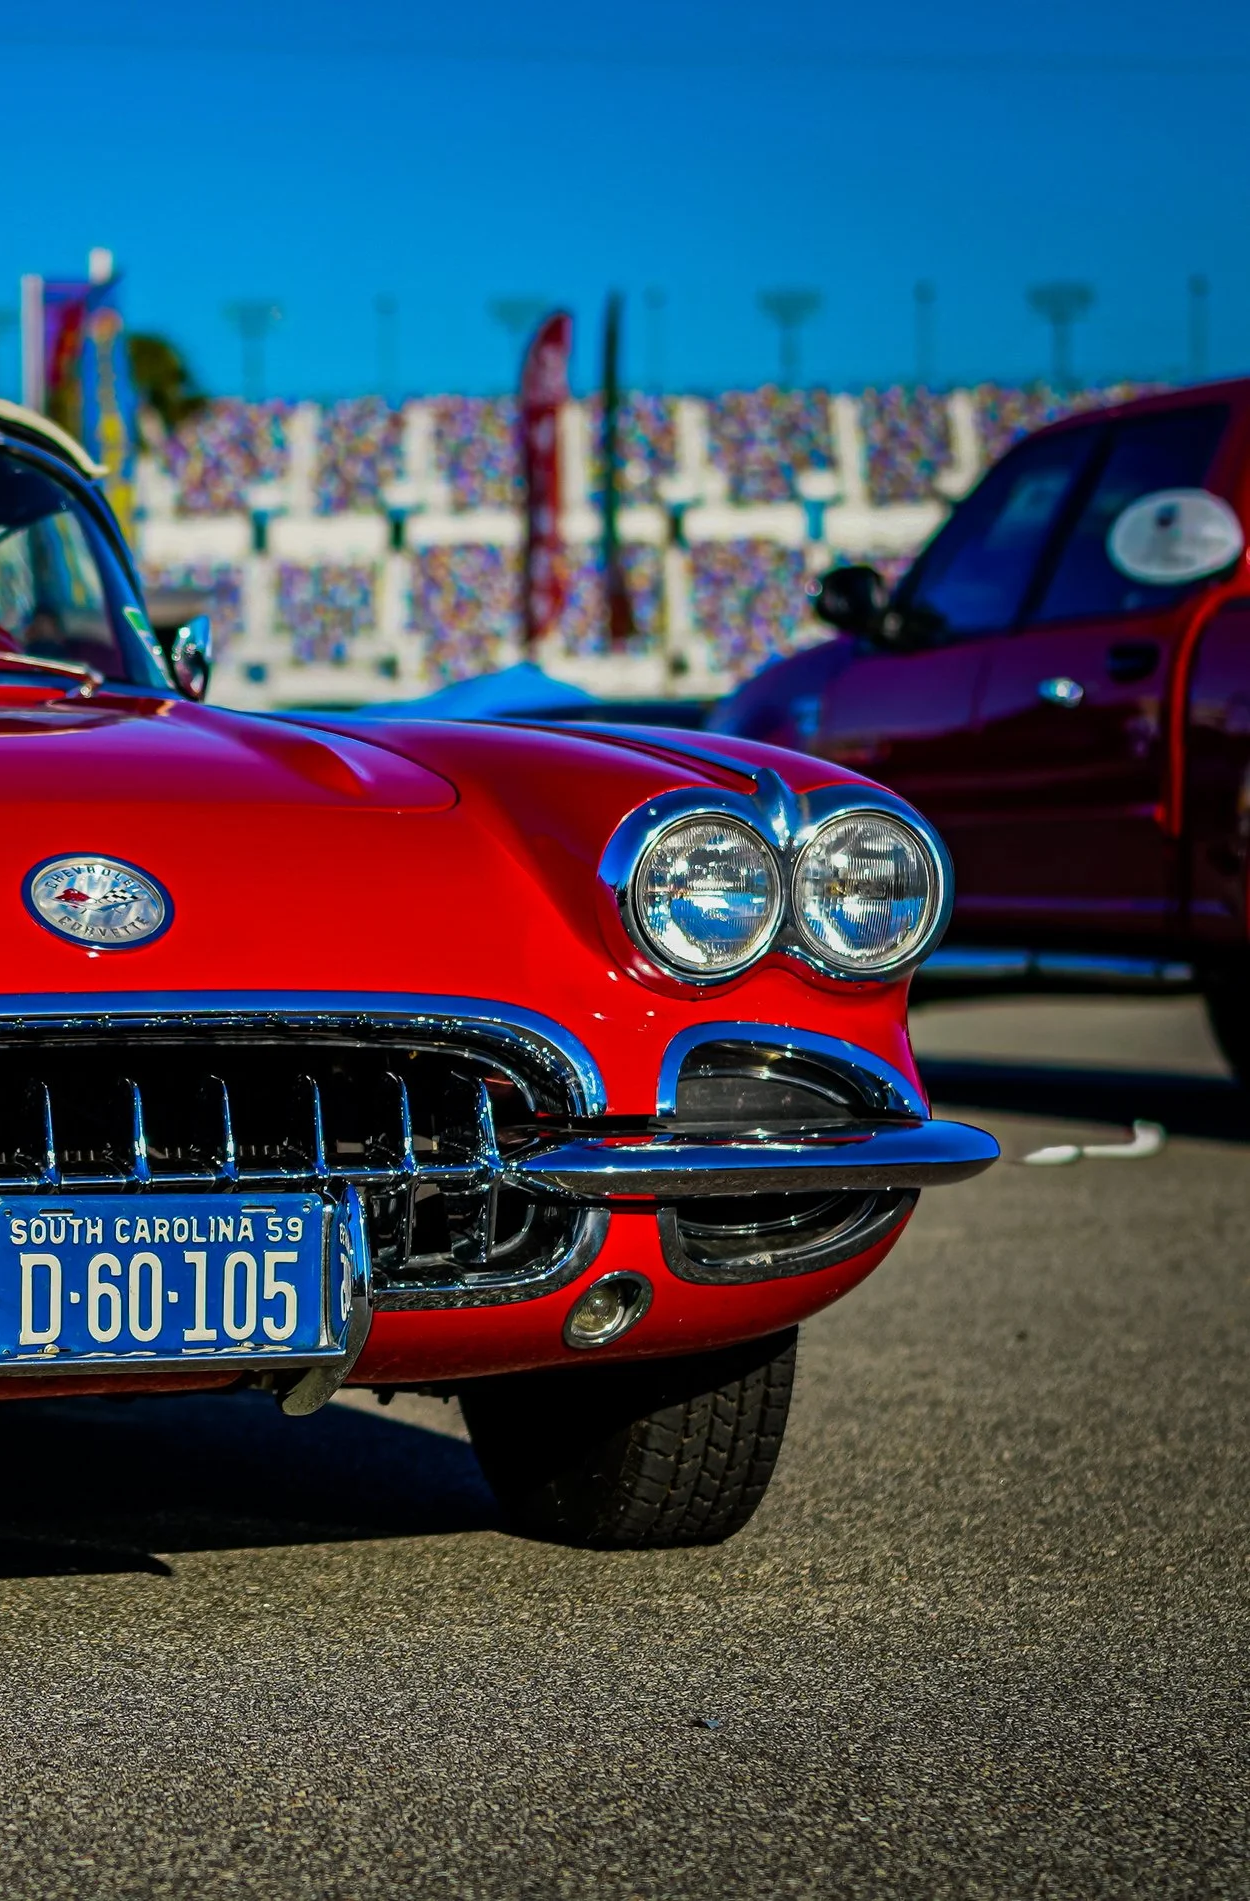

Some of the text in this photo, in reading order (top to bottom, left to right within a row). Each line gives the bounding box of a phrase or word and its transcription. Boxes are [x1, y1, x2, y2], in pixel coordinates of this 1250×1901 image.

[58, 916, 149, 938] CORVETTE
[11, 1216, 303, 1245] SOUTH CAROLINA 59
